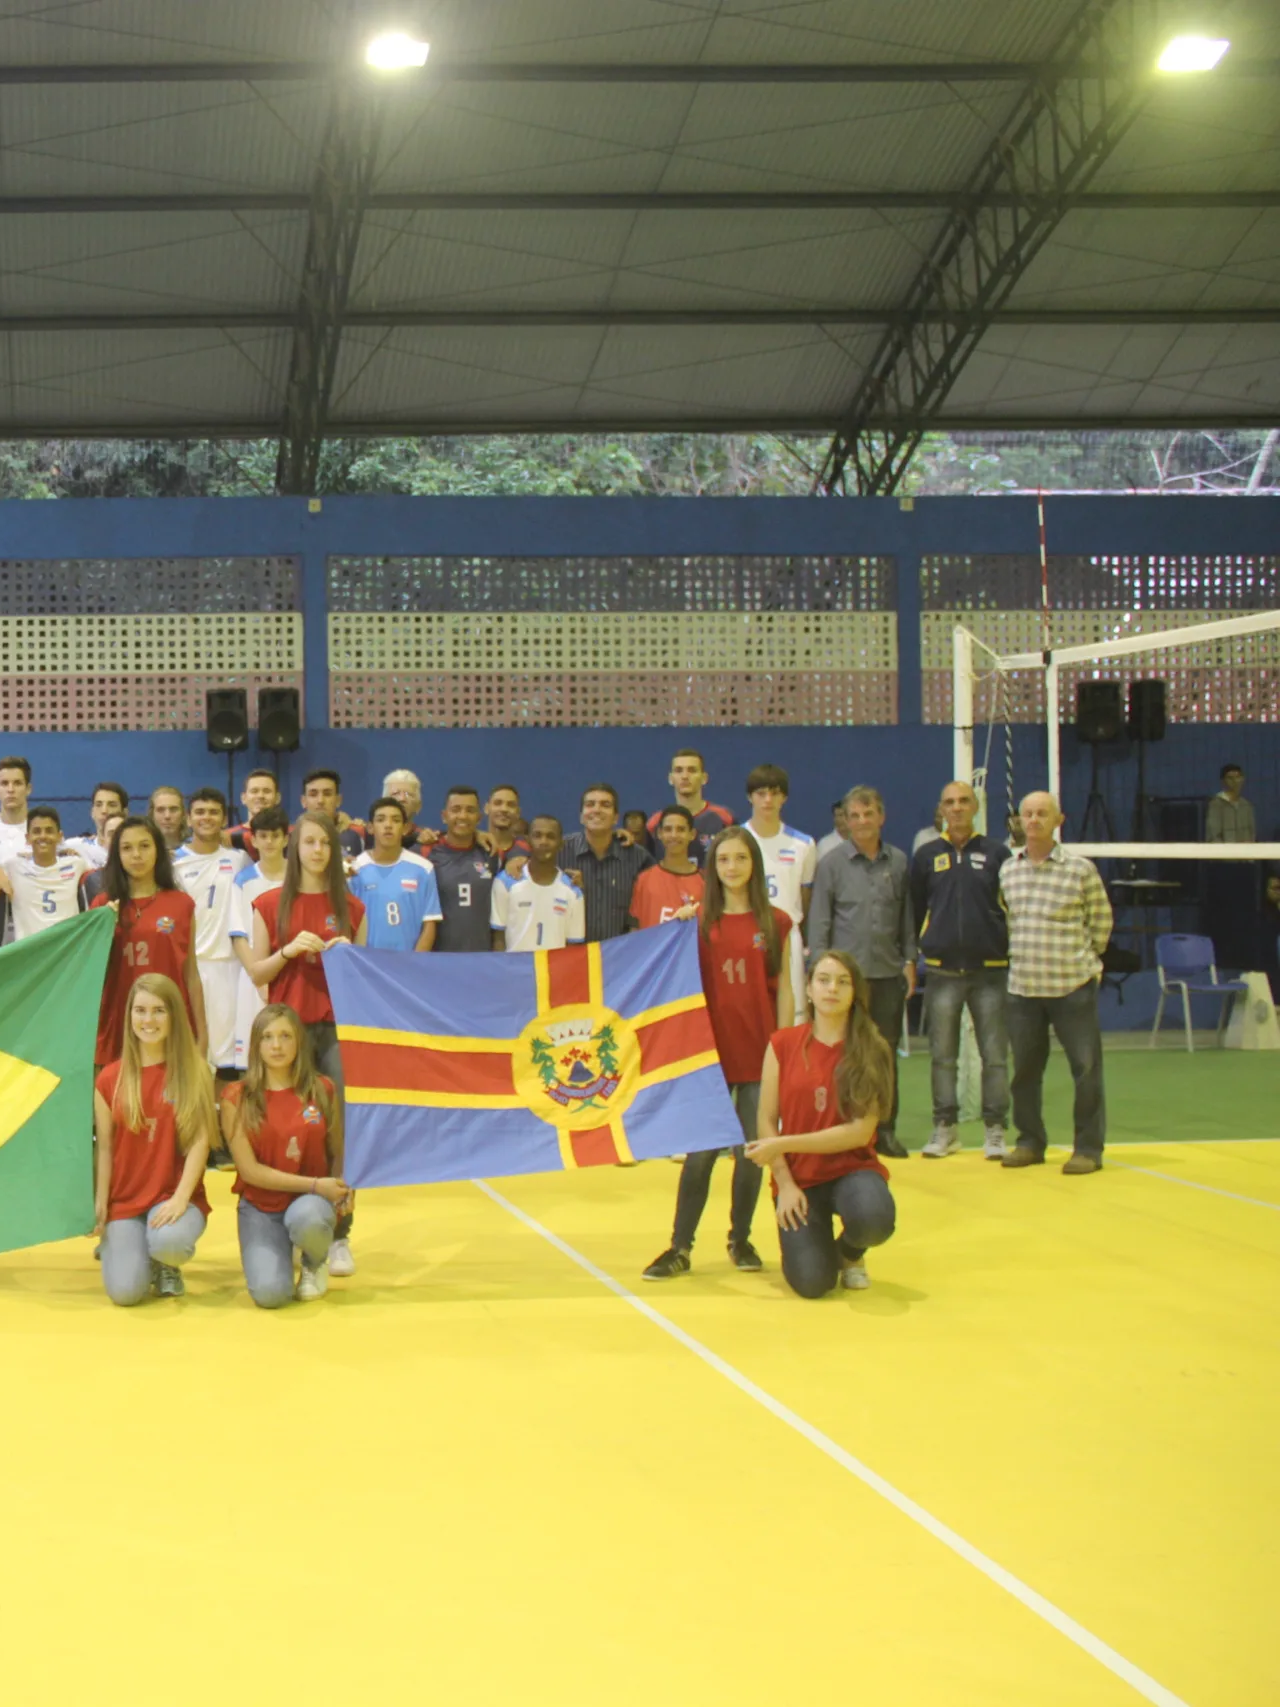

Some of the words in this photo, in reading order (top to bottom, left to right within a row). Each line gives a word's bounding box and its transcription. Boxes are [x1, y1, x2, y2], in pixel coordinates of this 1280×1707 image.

[42, 890, 57, 914] 5
[206, 884, 216, 909] 1
[458, 883, 471, 906] 9
[385, 901, 401, 926] 8
[536, 922, 543, 946] 1
[123, 940, 149, 967] 12
[722, 958, 746, 985] 11
[145, 1118, 157, 1143] 7
[285, 1136, 301, 1163] 4
